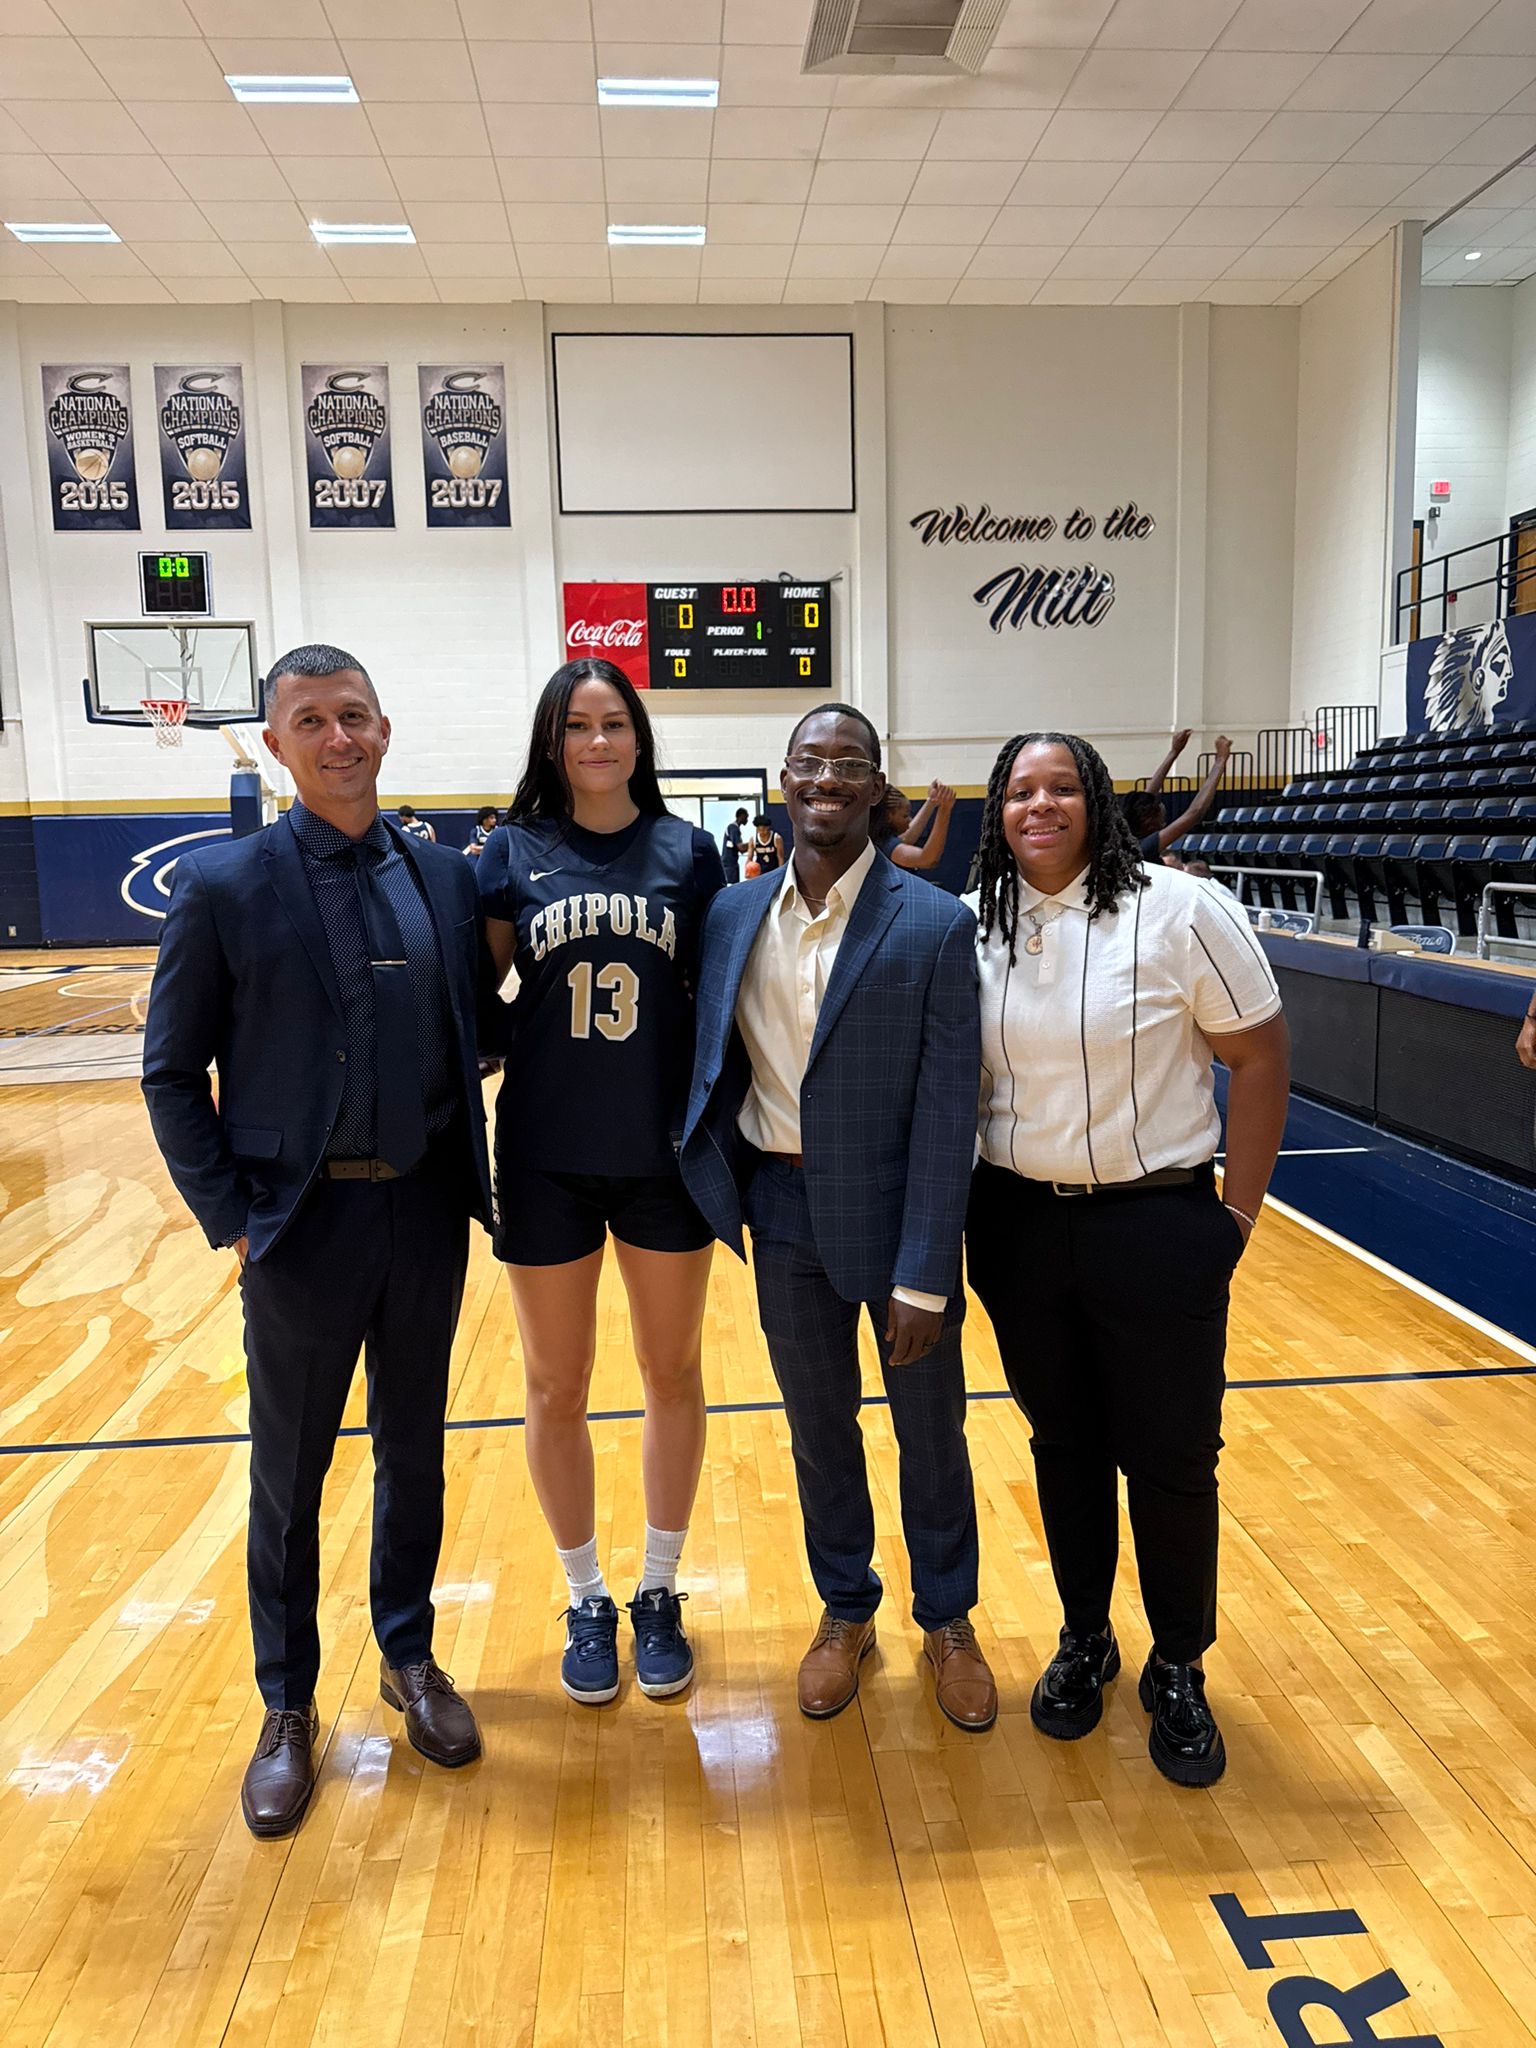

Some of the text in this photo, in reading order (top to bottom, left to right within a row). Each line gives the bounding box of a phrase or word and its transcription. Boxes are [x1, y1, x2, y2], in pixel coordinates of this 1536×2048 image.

[59, 396, 119, 411] NATIONAL
[171, 396, 231, 411] NATIONAL
[318, 395, 377, 410] NATIONAL
[435, 395, 493, 410] NATIONAL
[50, 411, 127, 430] CHAMPIONS
[163, 411, 239, 430] CHAMPIONS
[309, 409, 384, 429] CHAMPIONS
[426, 409, 500, 429] CHAMPIONS
[66, 431, 116, 442] WOMEN'S
[67, 440, 115, 450] BASKETBALL
[178, 433, 226, 449] SOFTBALL
[323, 432, 372, 448] SOFTBALL
[440, 432, 488, 447] BASEBALL
[60, 481, 129, 511] 2015
[172, 481, 240, 510] 2015
[314, 479, 387, 508] 2007
[431, 479, 502, 508] 2007
[910, 501, 1156, 546] Welcome to the
[654, 587, 697, 600] GUEST
[722, 587, 756, 613] 0.0
[783, 587, 820, 599] HOME
[973, 563, 1115, 633] Milt
[679, 604, 693, 629] 0
[804, 603, 819, 628] 0
[566, 619, 647, 647] Coca-Cola
[707, 626, 744, 636] PERIOD
[756, 621, 762, 640] 1
[664, 649, 691, 657] FOULS
[790, 647, 816, 656] FOULS
[674, 658, 687, 677] 0
[799, 657, 811, 676] 0
[530, 892, 677, 961] CHIPOLA
[567, 961, 640, 1041] 13
